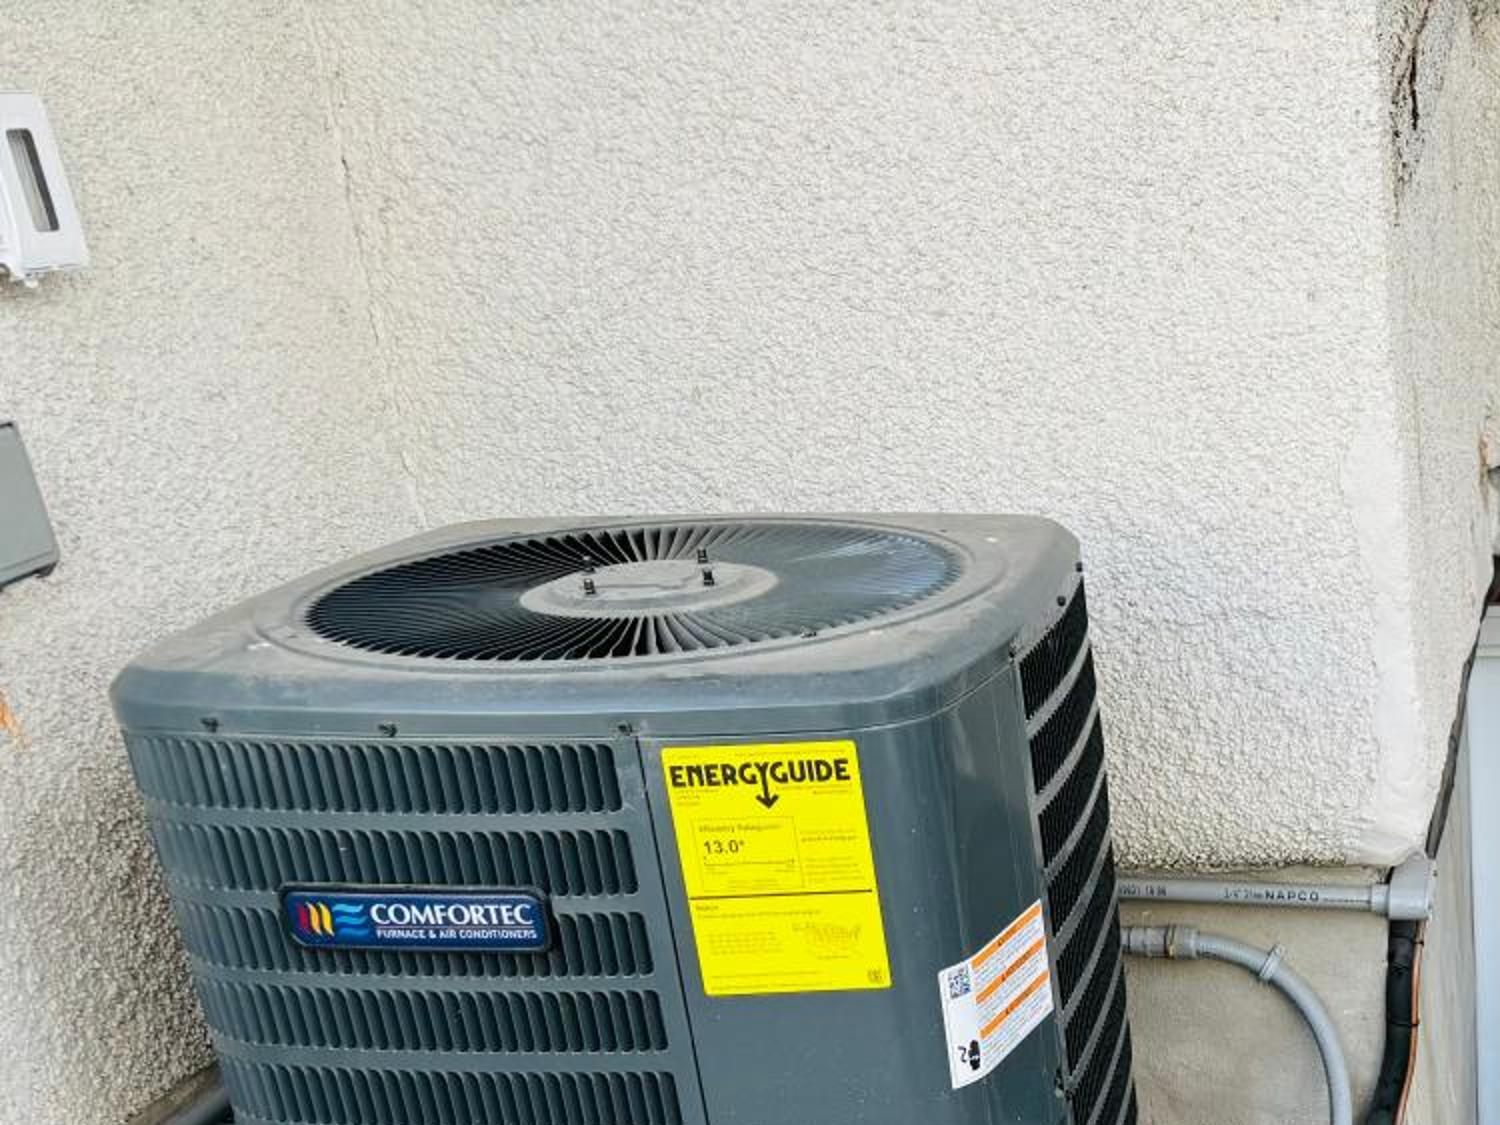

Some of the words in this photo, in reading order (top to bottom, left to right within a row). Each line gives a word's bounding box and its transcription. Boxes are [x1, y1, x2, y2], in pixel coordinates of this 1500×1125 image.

[669, 758, 851, 789] ENERGYGUIDE
[1265, 888, 1319, 901] NAPCO
[370, 903, 535, 925] COMFORTEC
[377, 929, 427, 939] FURNACE
[429, 929, 437, 939] &
[439, 929, 457, 939] AIR
[458, 930, 538, 939] CONDITIONERS
